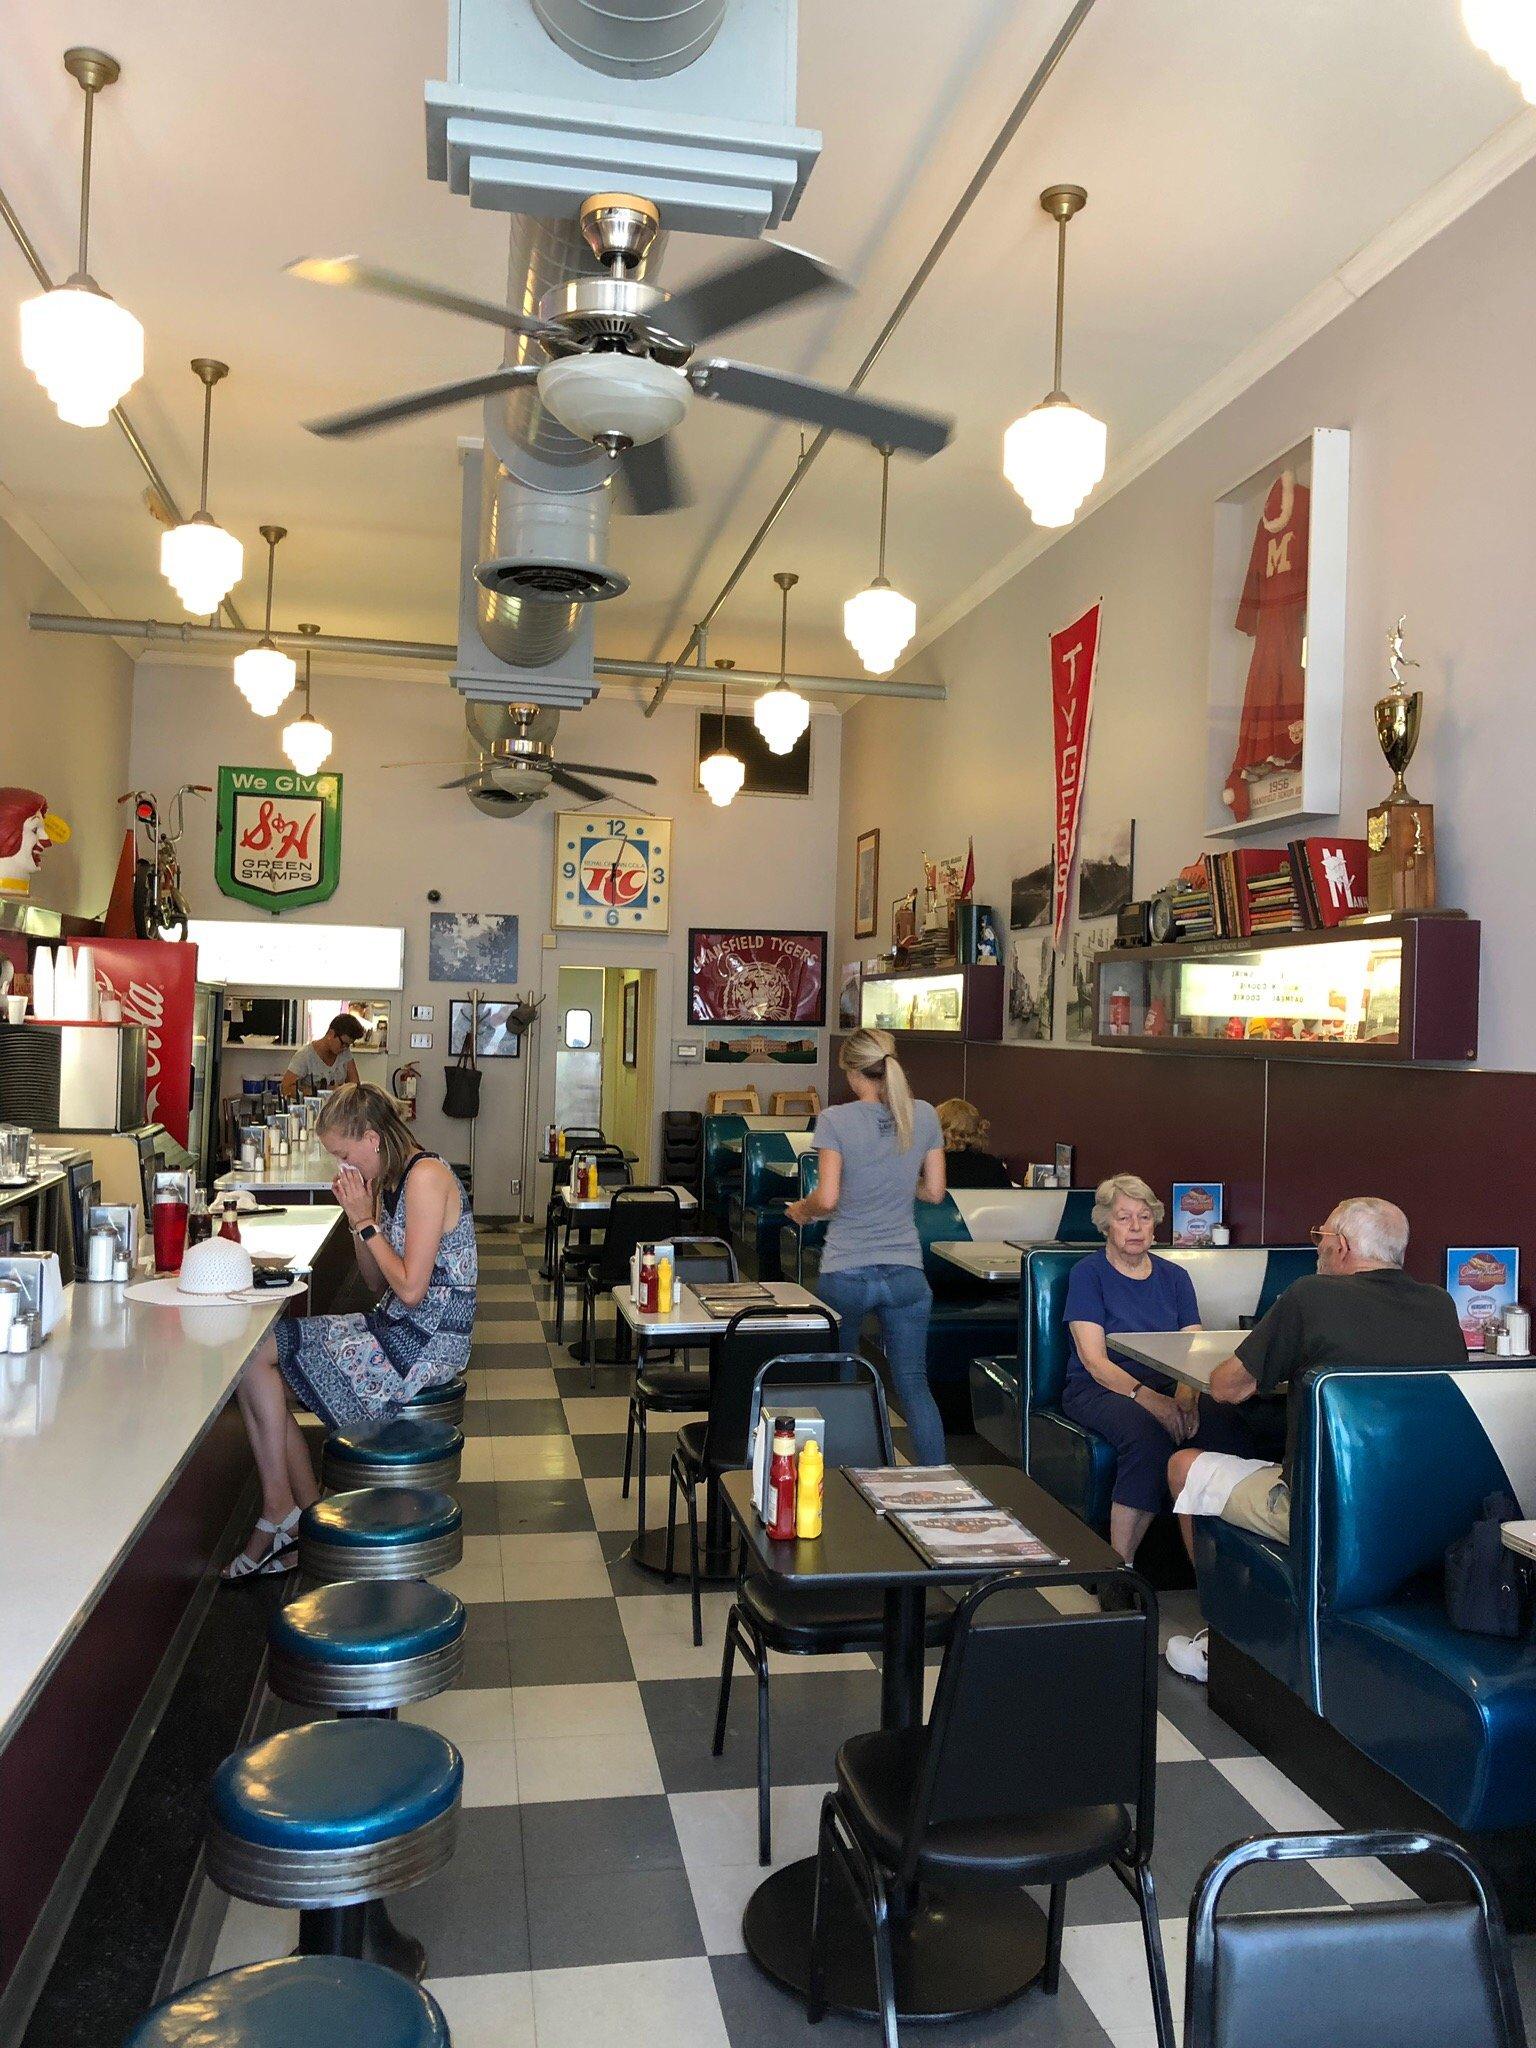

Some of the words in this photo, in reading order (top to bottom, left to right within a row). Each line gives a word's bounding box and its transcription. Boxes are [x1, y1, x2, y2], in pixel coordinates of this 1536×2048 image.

[1056, 641, 1083, 893] TYGERS
[232, 773, 268, 789] We
[1269, 778, 1289, 793] 1956
[607, 820, 626, 836] 12
[242, 859, 312, 871] GREEN
[563, 862, 576, 879] 9
[242, 869, 312, 882] STAMPS
[653, 867, 665, 884] 3
[583, 867, 646, 905] RC
[606, 909, 619, 926] 6
[770, 936, 819, 966] TYGERS
